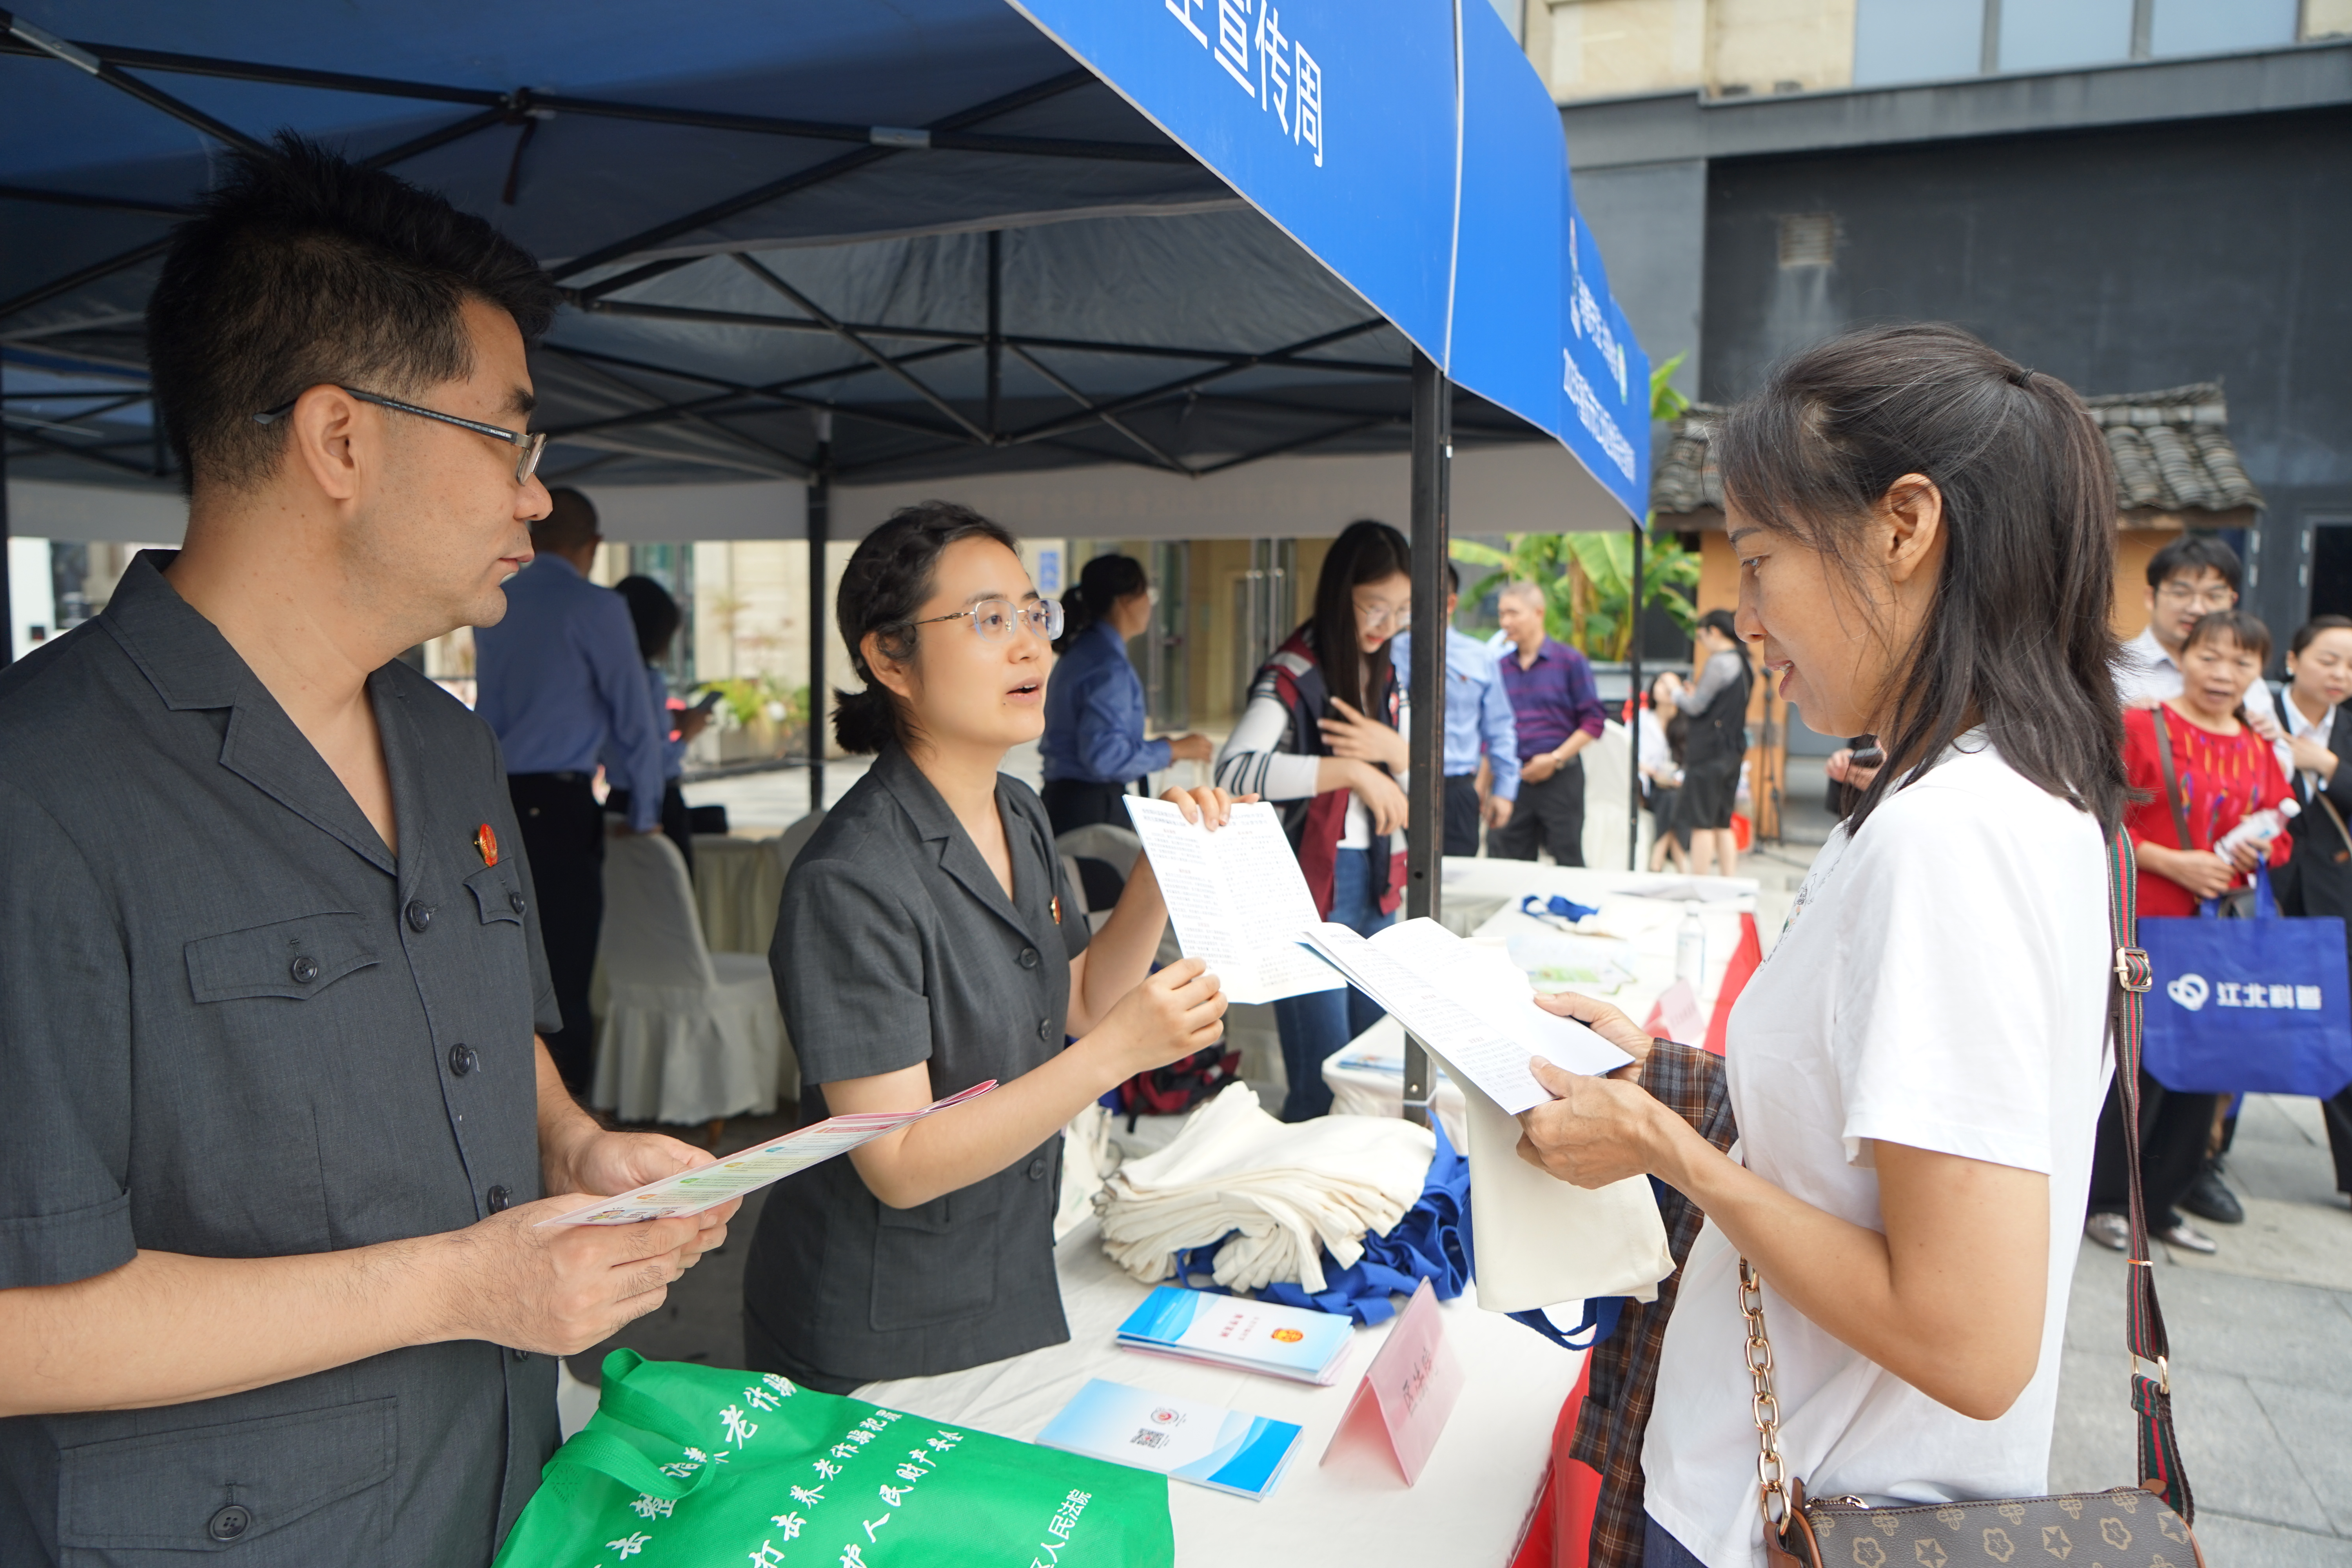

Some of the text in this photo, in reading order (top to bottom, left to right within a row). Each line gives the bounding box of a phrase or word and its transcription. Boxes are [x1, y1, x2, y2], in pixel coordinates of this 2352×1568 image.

[1166, 0, 1323, 167] 宣传周
[593, 1373, 797, 1568] 击整治养老诈骗
[748, 1409, 903, 1568] 打击养老诈骗犯罪
